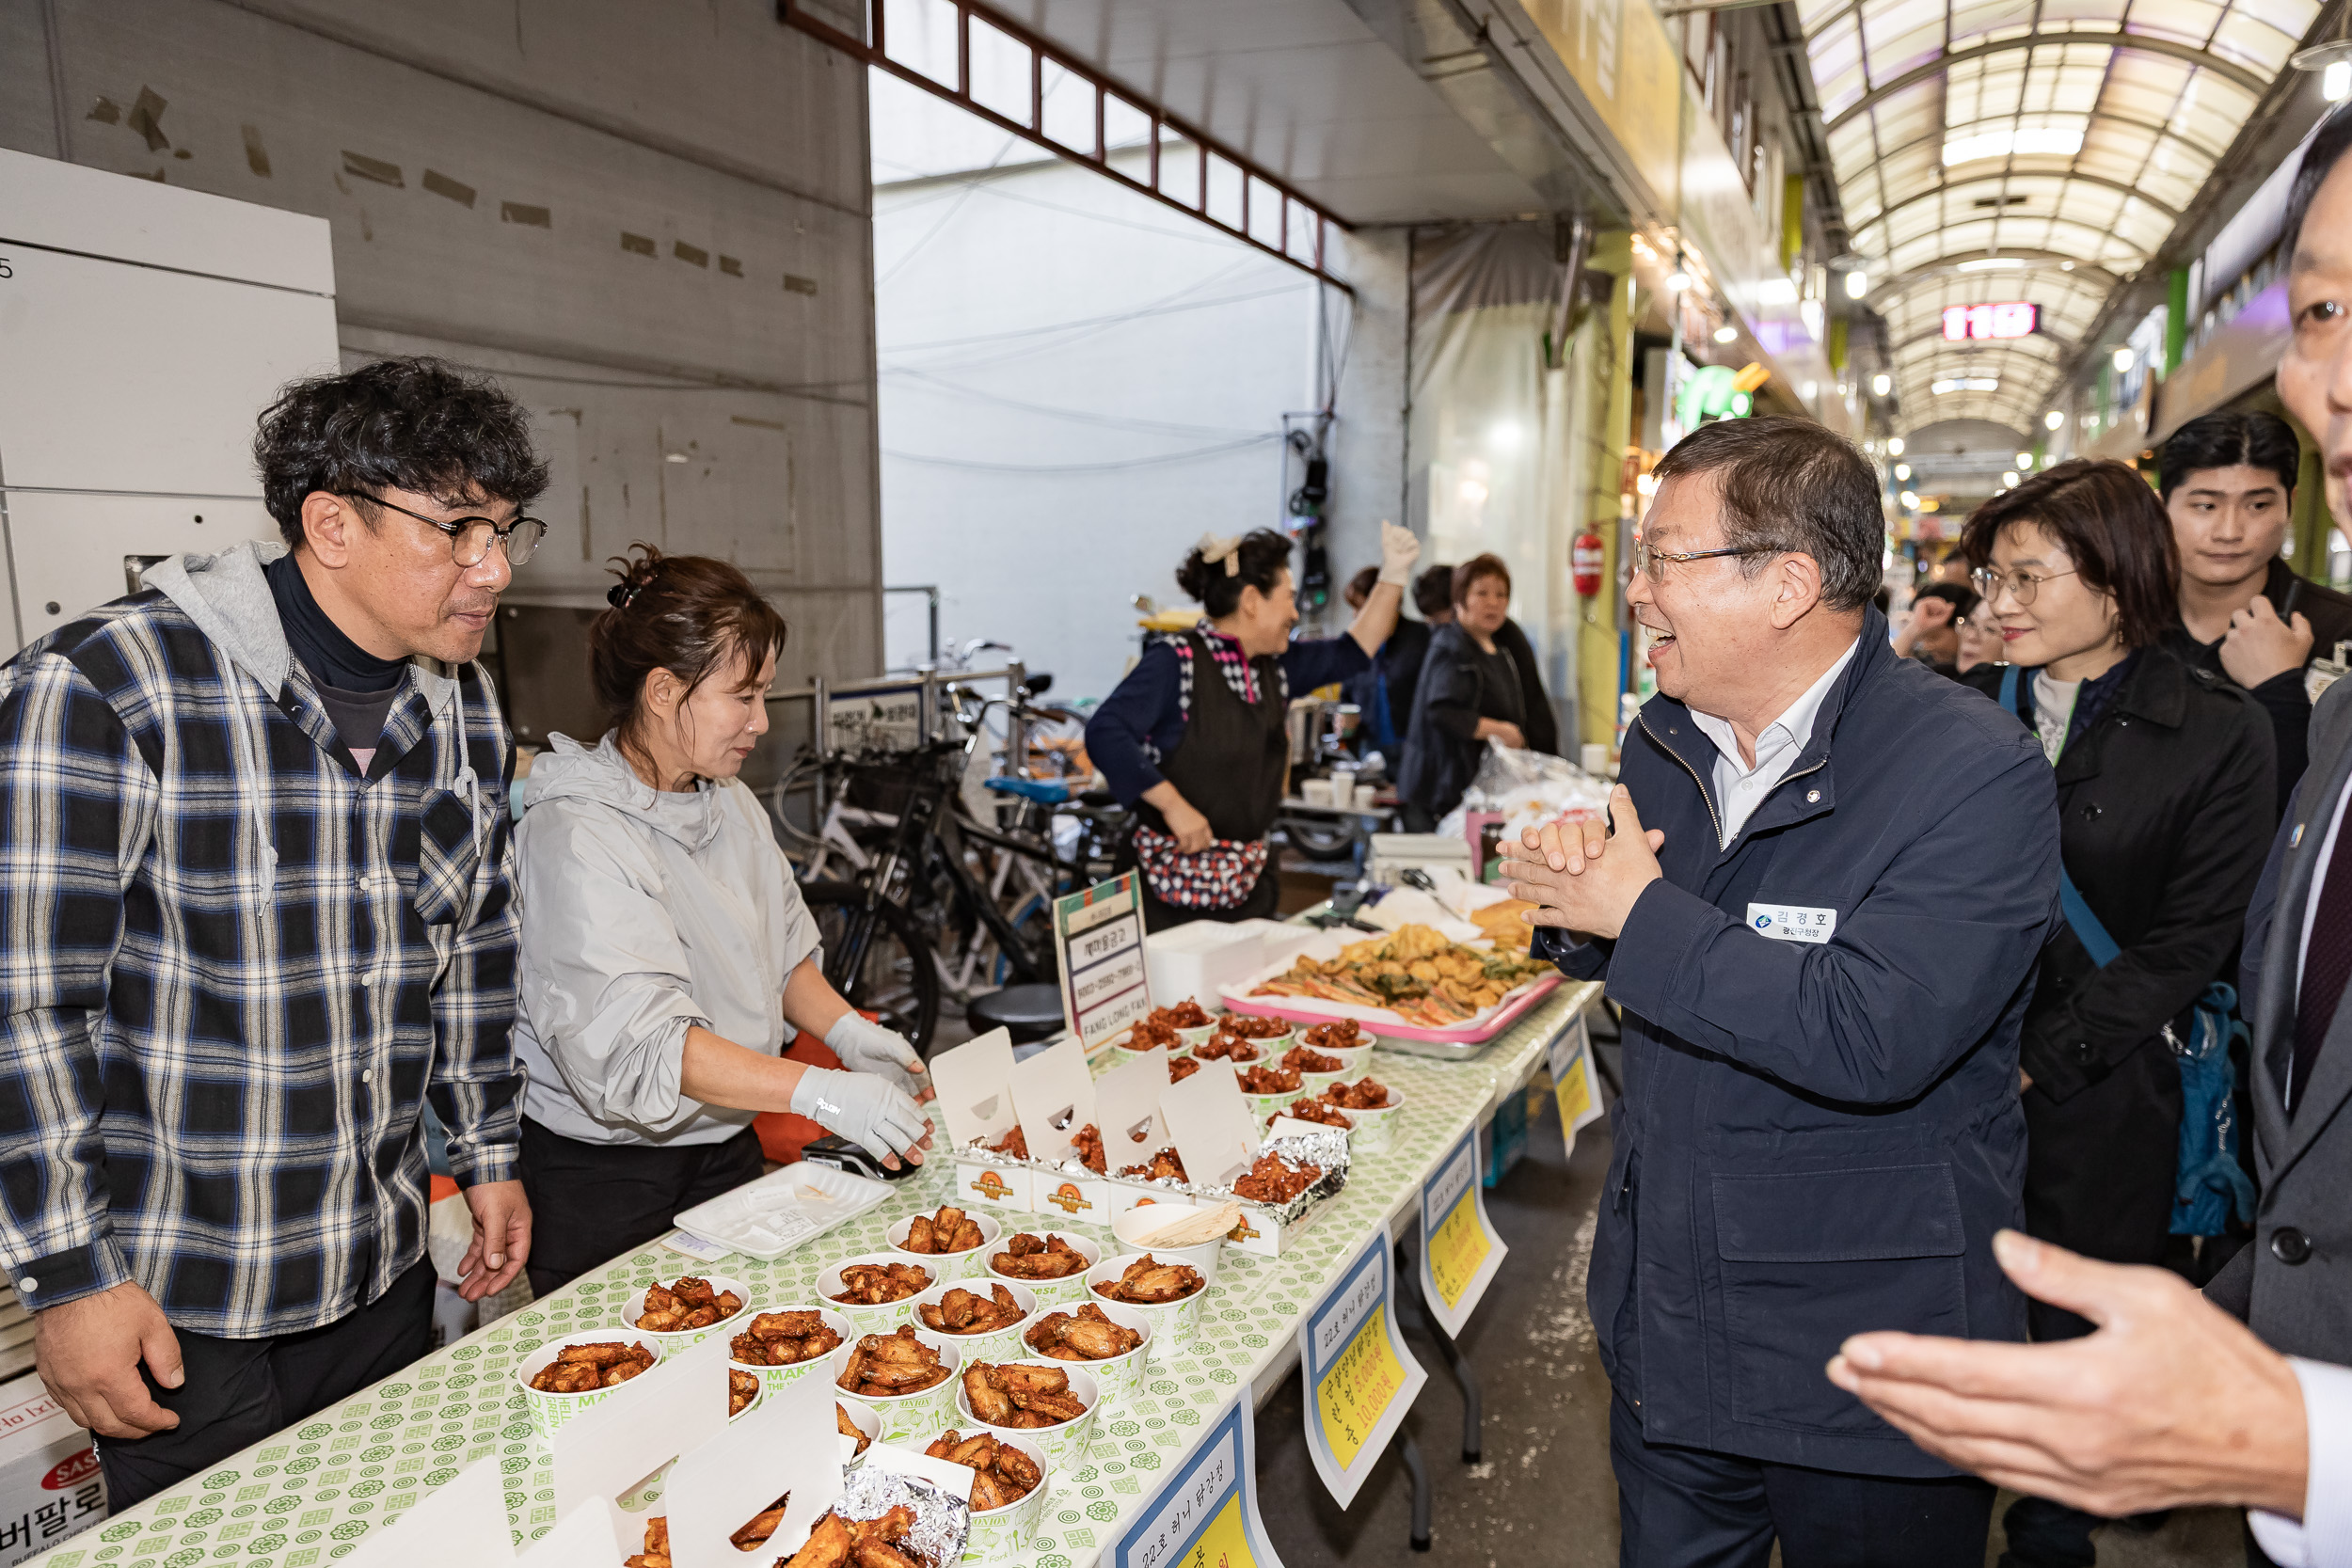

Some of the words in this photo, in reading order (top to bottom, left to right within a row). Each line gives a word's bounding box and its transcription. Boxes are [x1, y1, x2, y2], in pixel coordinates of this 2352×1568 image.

[1783, 927, 1820, 937] 광진구청장
[1324, 1321, 1340, 1351] 22호
[900, 1399, 930, 1407] ONION
[914, 1430, 930, 1440] Fork
[1344, 1423, 1359, 1446] 중
[1142, 1533, 1168, 1568] 22호
[1171, 1499, 1191, 1534] 허니
[1195, 1459, 1224, 1508] 닭강정
[974, 1516, 1007, 1525] ONION
[989, 1551, 1008, 1562] Fork
